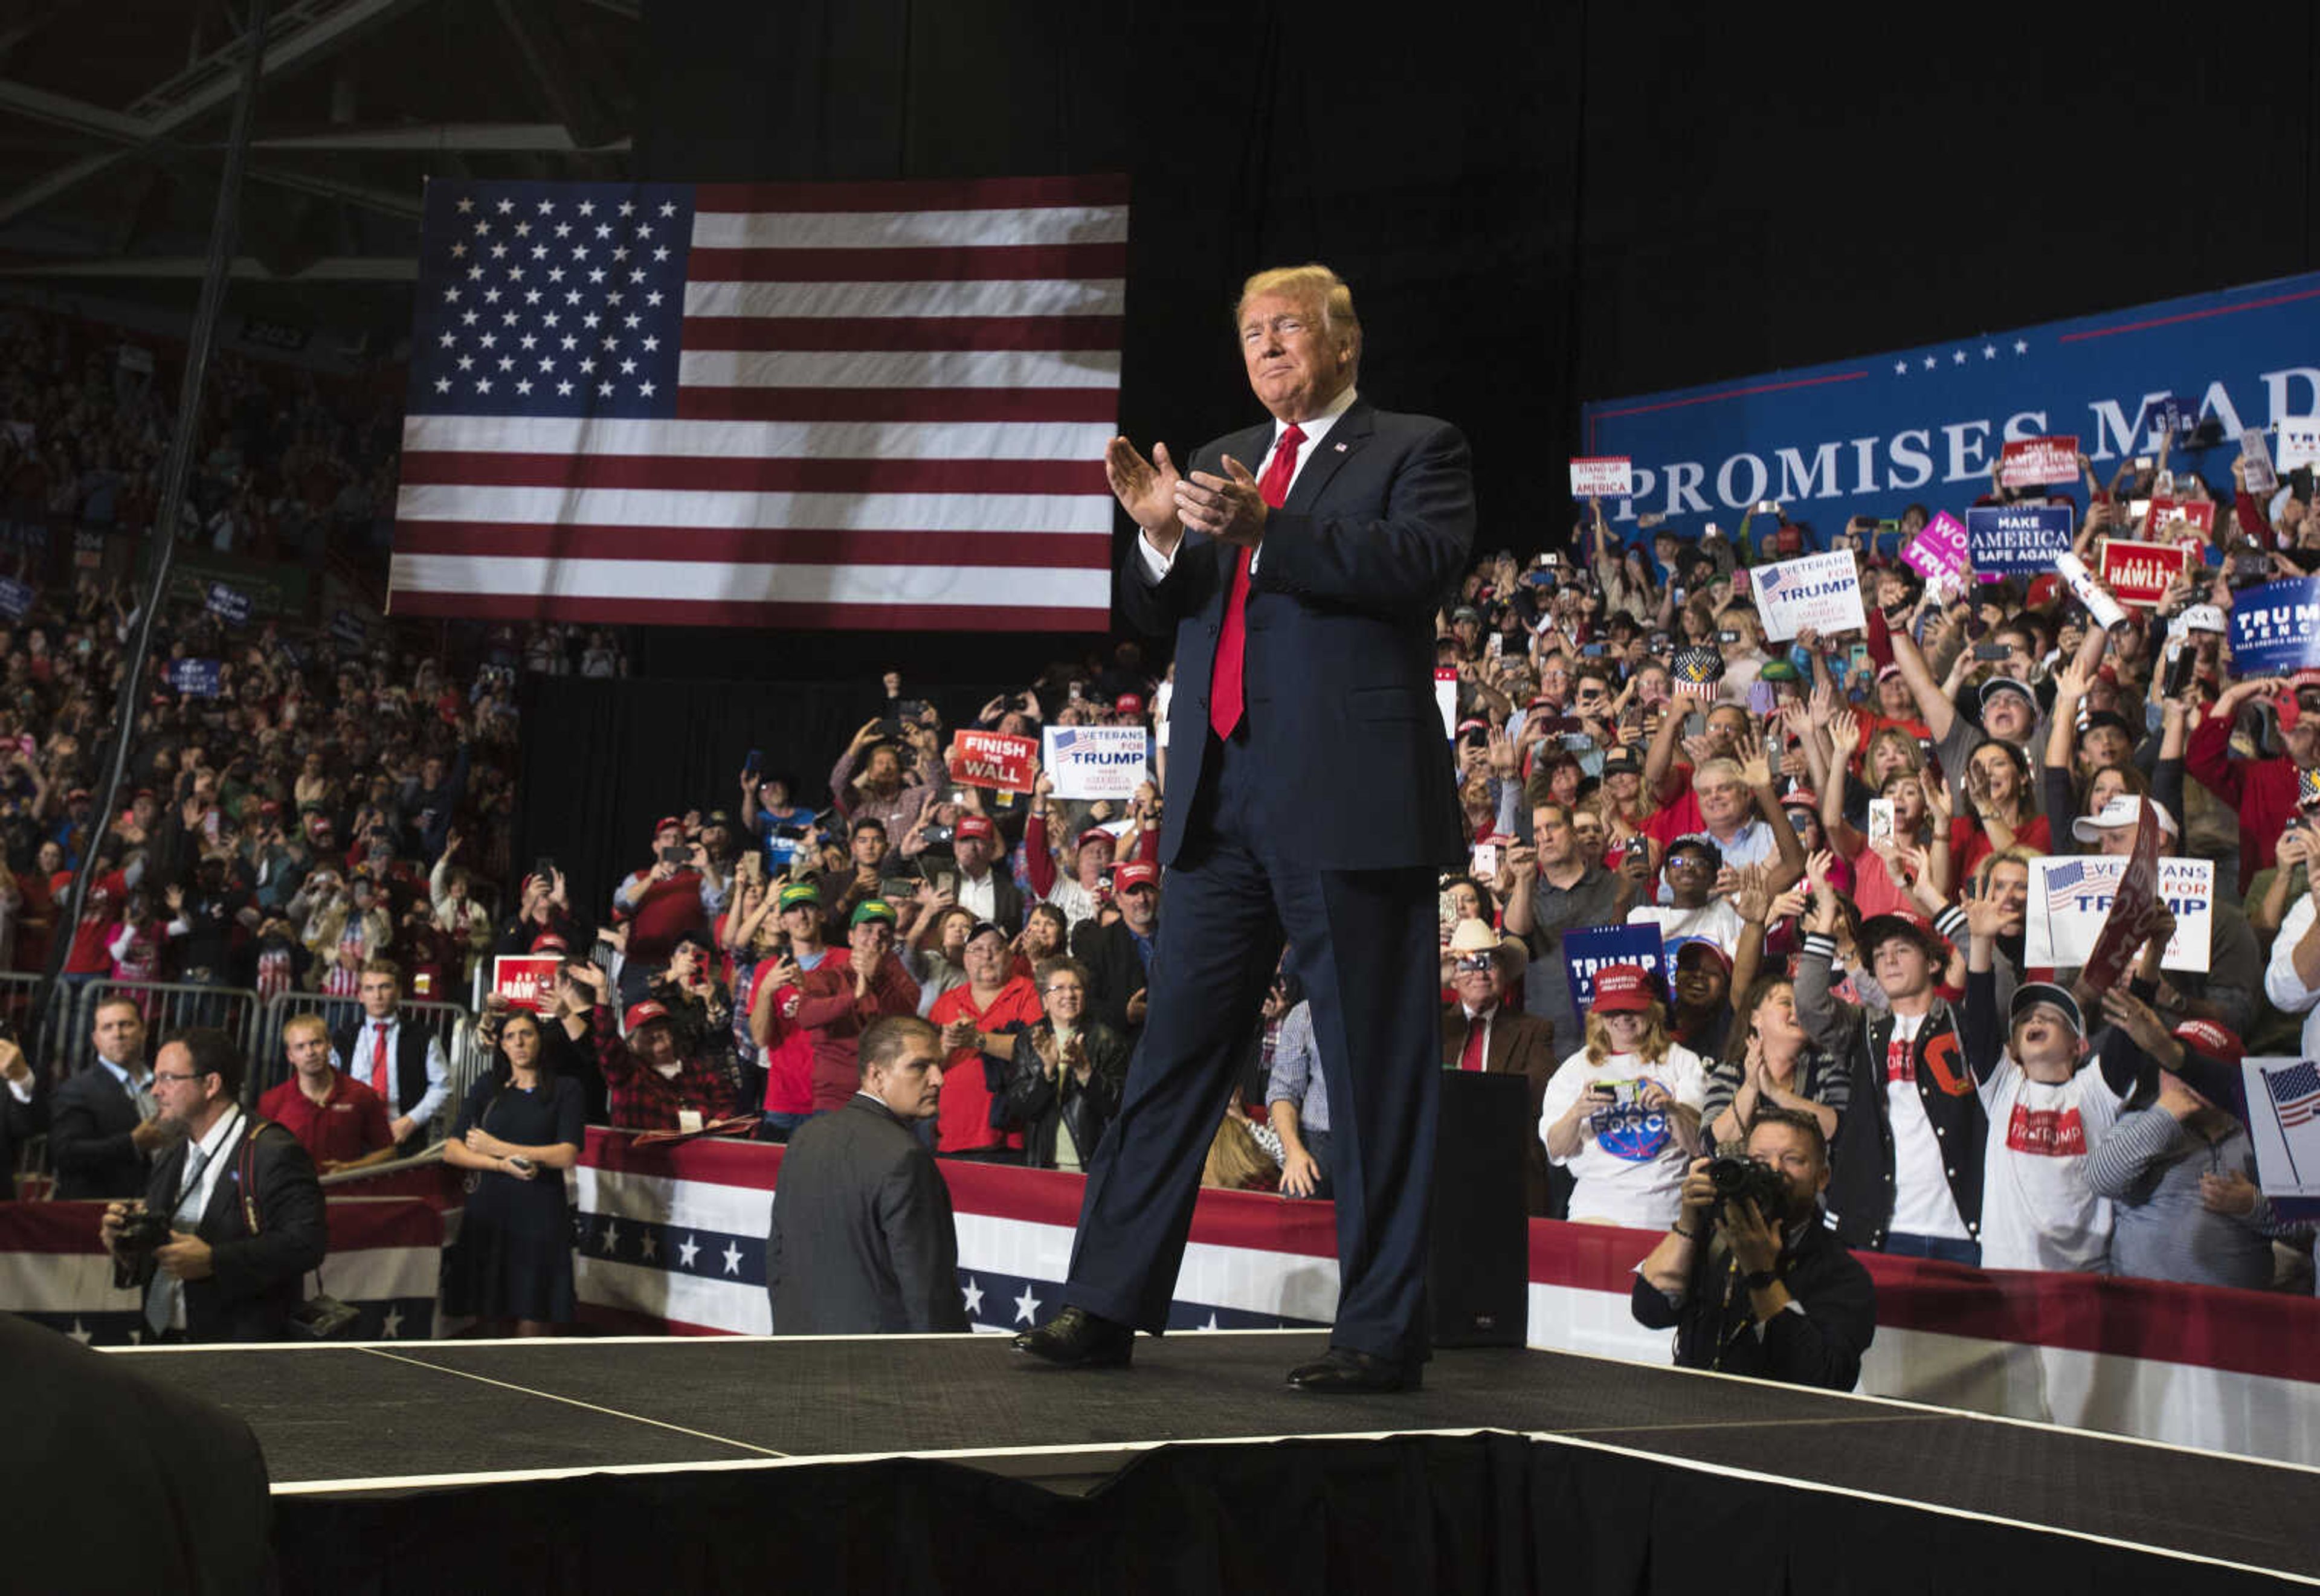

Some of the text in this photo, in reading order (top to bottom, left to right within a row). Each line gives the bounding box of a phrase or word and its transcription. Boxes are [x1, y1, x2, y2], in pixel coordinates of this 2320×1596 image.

[1576, 482, 1626, 493] AMERICA
[1998, 516, 2040, 530] MAKE
[1971, 529, 2069, 549] AMERICA
[1977, 550, 2013, 562] SAFE
[1785, 555, 1851, 576] VETERANS
[1828, 567, 1852, 580] FOR
[2110, 565, 2176, 588] HAWLEY
[1779, 578, 1855, 603] TRUMP
[1082, 731, 1144, 740] VETERANS
[965, 736, 1026, 758] FINISH
[1122, 742, 1144, 750] FOR
[984, 753, 1003, 764] THE
[1071, 753, 1144, 764] TRUMP
[965, 759, 1020, 783] WALL
[2095, 863, 2208, 880] VEANS
[2164, 882, 2208, 895] FOR
[2075, 896, 2207, 915] TRP
